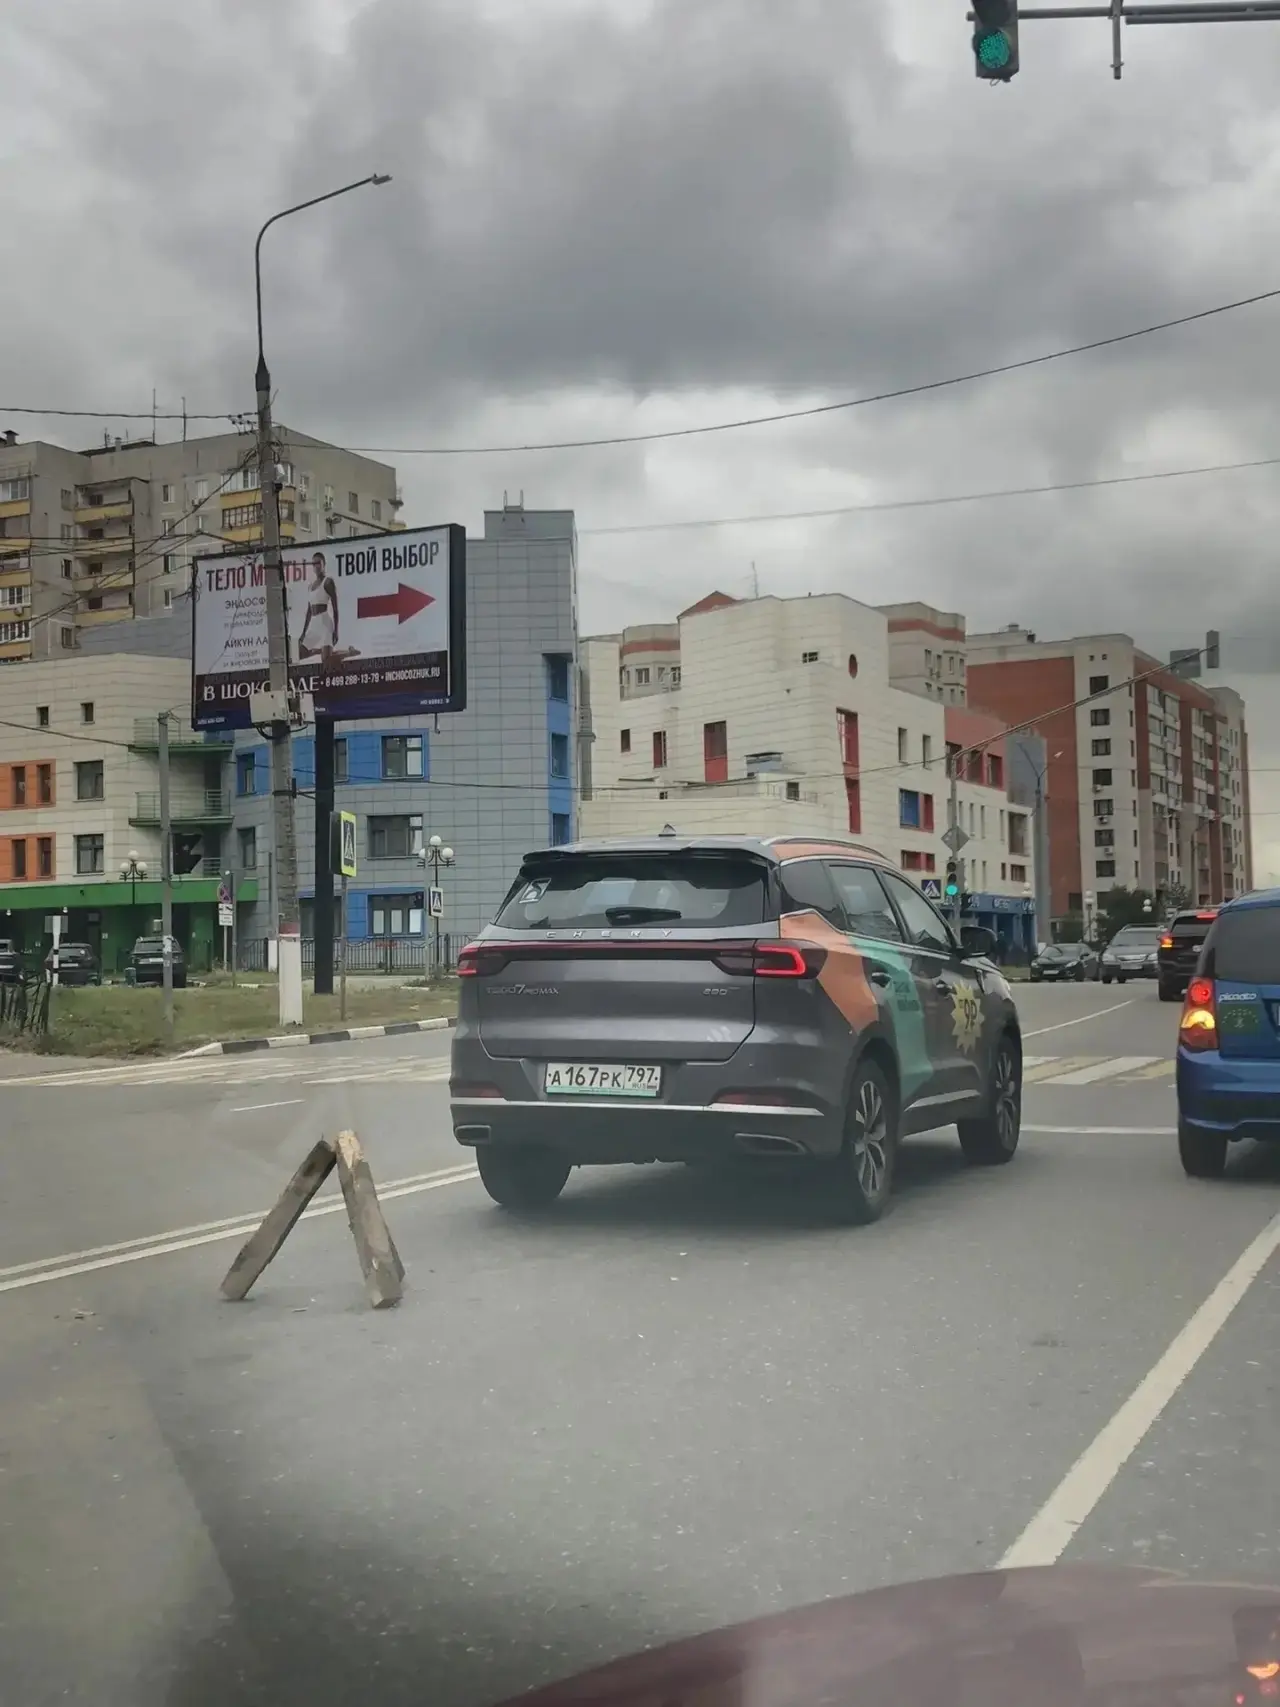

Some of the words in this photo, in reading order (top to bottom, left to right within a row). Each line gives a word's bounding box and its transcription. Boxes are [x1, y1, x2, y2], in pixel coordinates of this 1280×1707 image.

[335, 546, 377, 577] ТВОЙ
[381, 541, 439, 572] ВЫБОР
[206, 566, 246, 592] ТЕЛО
[250, 561, 306, 588] МТЫ
[224, 597, 267, 610] ЭНДОСФ
[255, 635, 269, 646] ЛА
[203, 685, 215, 701] В
[221, 676, 319, 700] ШОКОАДЕ
[325, 677, 330, 687] 8
[331, 676, 344, 686] 499
[546, 929, 672, 939] CHERY
